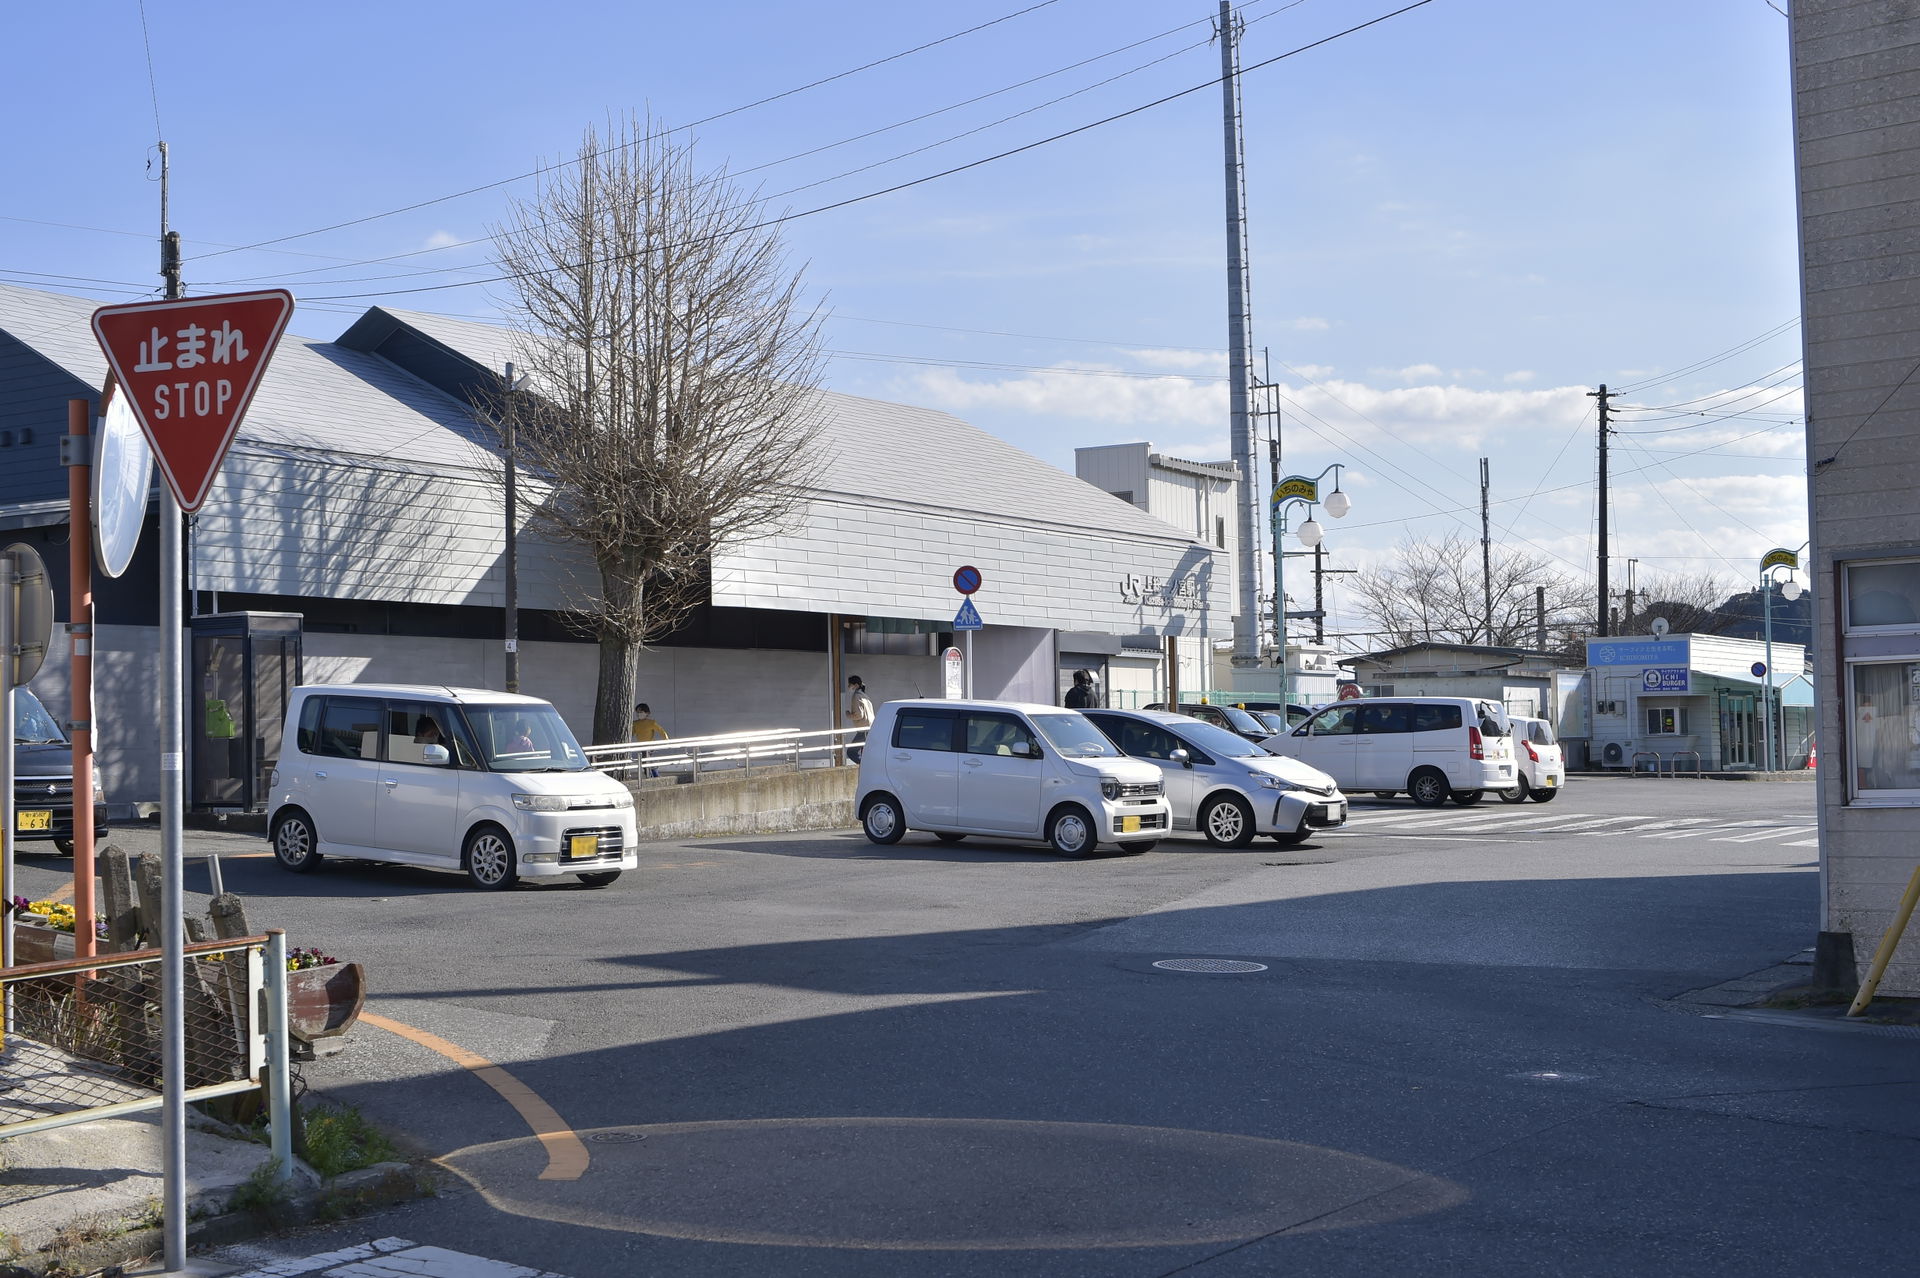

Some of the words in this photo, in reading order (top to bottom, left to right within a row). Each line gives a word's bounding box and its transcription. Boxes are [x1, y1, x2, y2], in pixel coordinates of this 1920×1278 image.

[134, 320, 249, 373] 止まれ
[154, 379, 232, 420] STOP
[1276, 484, 1314, 498] いちのみや
[1120, 573, 1140, 598] JR
